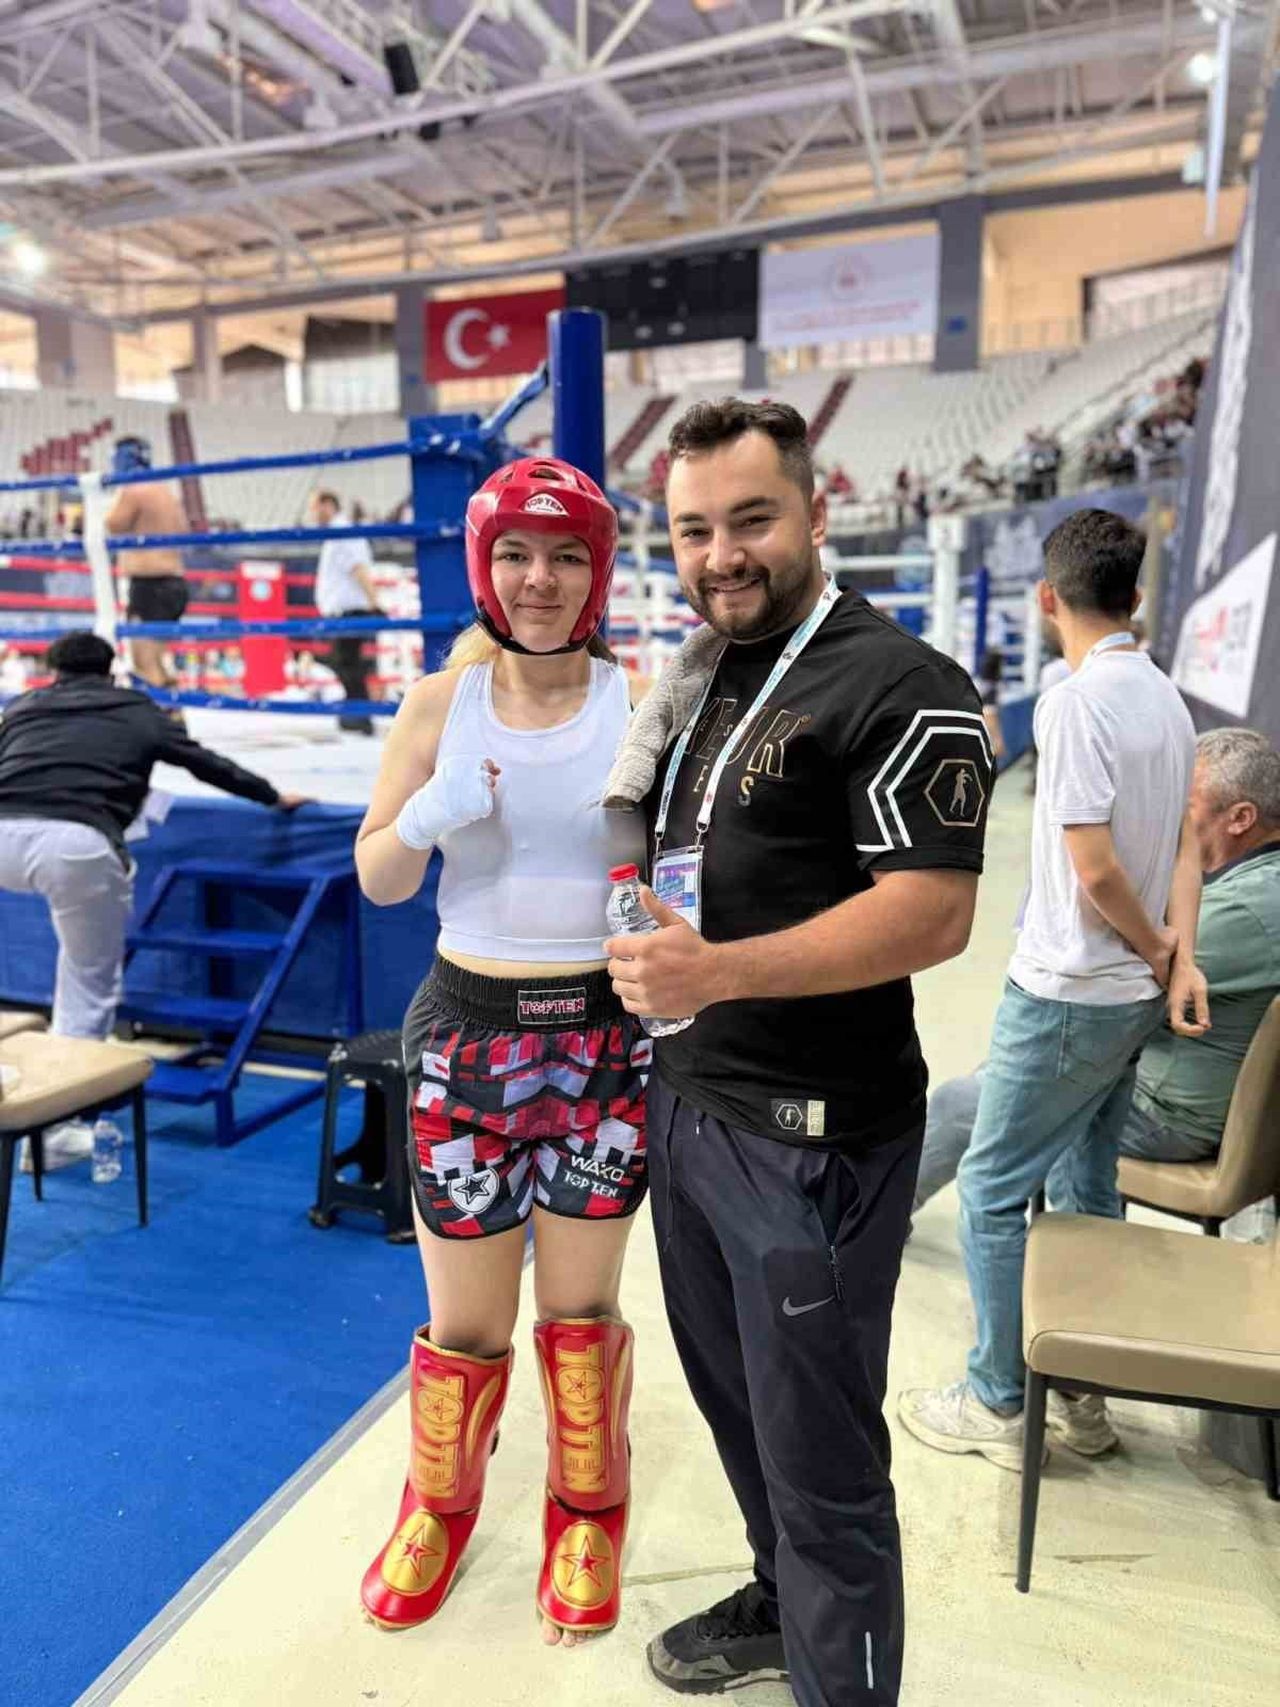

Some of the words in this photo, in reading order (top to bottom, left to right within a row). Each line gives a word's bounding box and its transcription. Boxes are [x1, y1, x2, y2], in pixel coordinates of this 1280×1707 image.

[571, 1155, 625, 1182] WAKO
[563, 1169, 589, 1189] TOP
[590, 1180, 619, 1198] TEN
